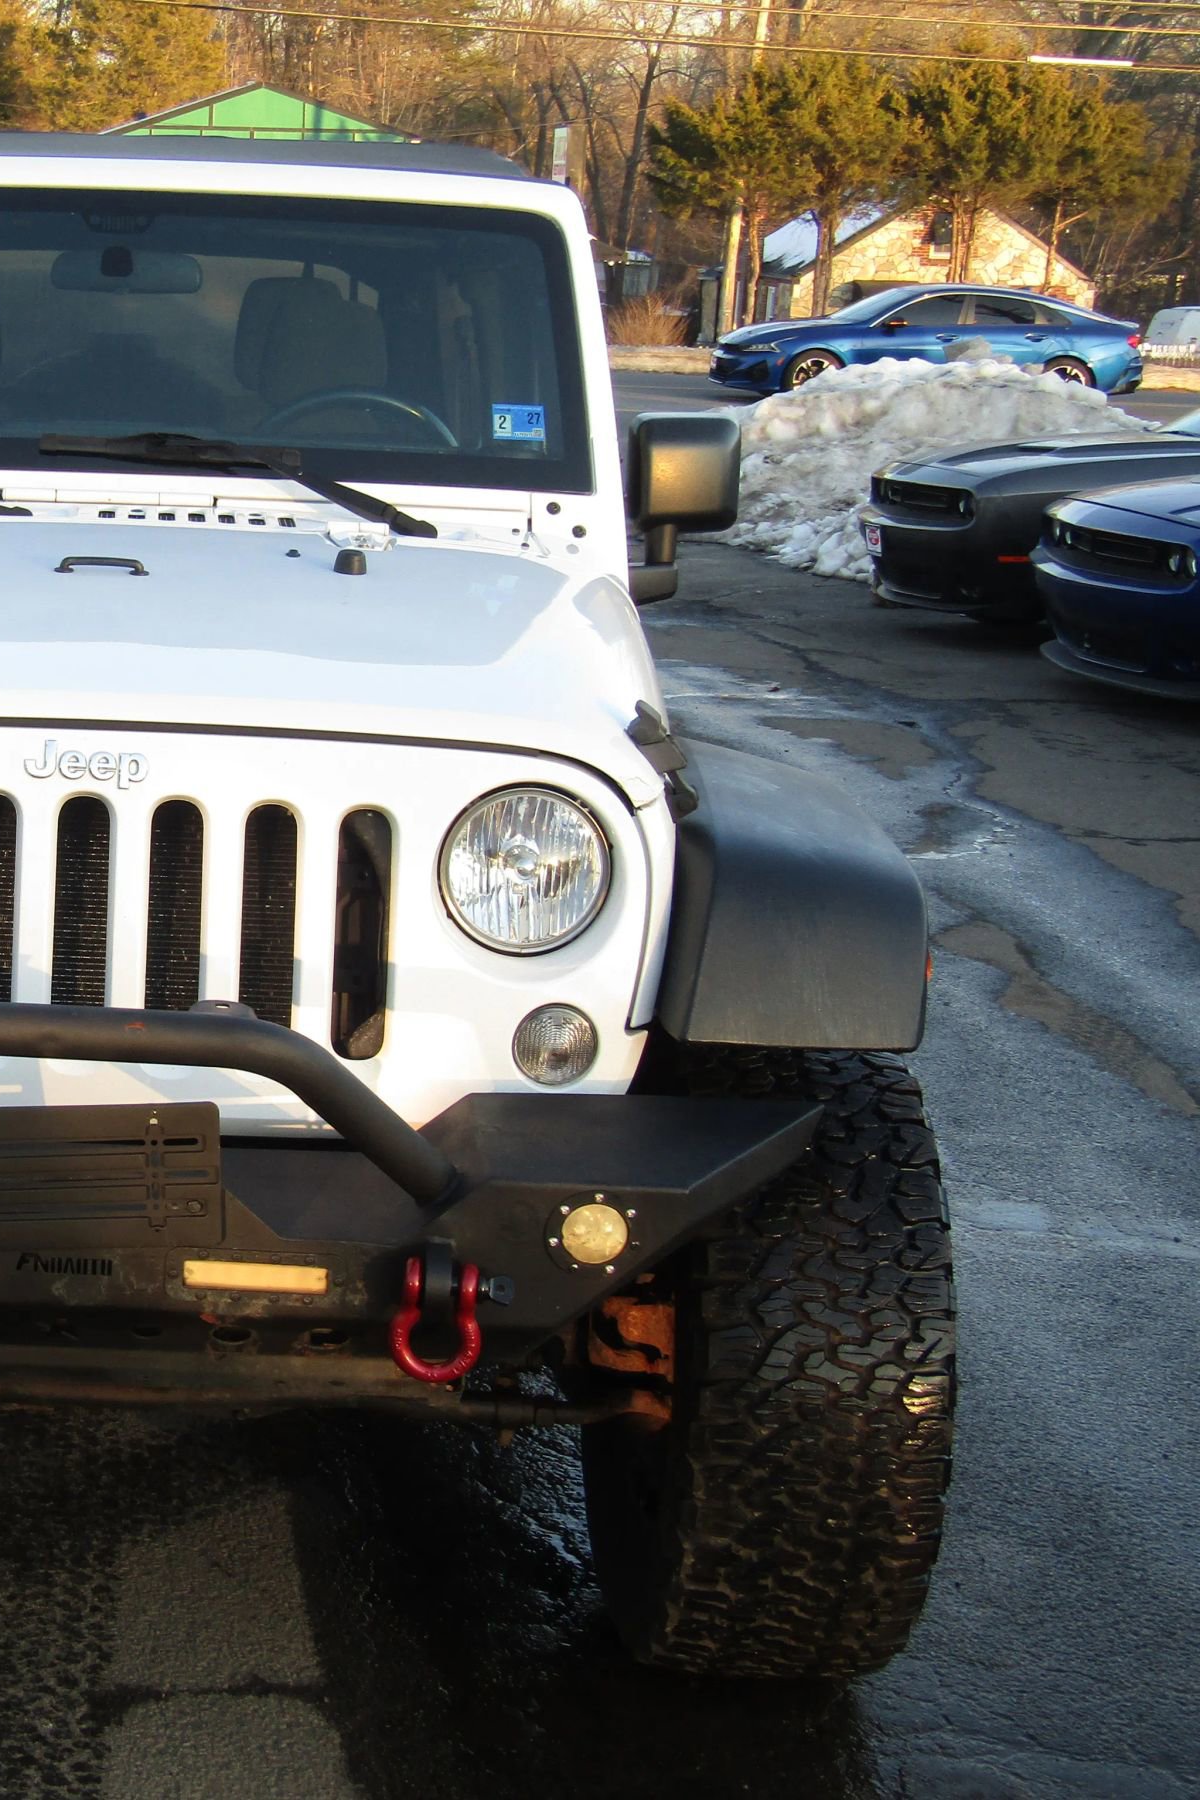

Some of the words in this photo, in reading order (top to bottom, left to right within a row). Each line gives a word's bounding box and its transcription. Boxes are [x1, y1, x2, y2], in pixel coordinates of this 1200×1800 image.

[498, 415, 507, 430] 2
[527, 412, 541, 425] 27
[23, 739, 149, 790] Jeep
